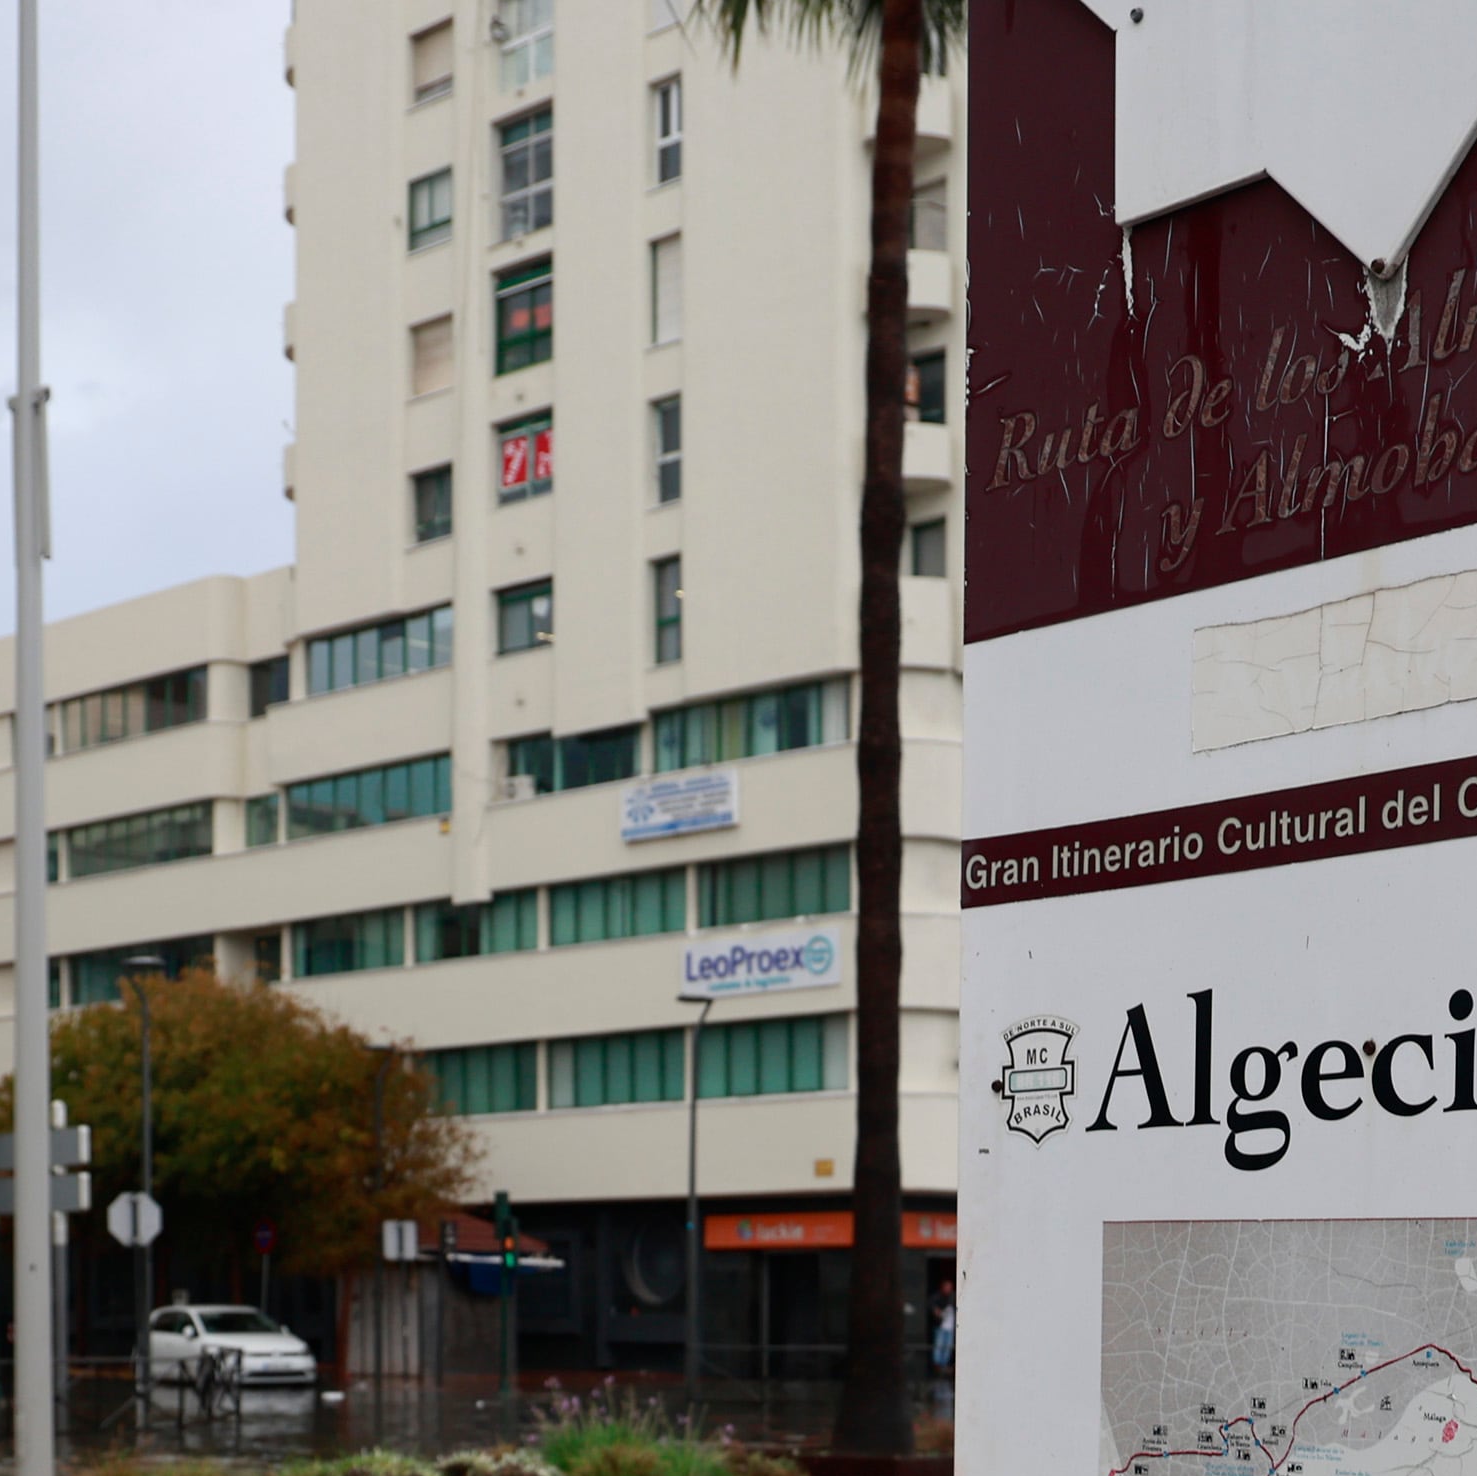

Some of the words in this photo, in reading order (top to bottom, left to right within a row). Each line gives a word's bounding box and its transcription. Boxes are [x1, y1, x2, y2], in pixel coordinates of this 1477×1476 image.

[986, 402, 1141, 493] Ruta
[1163, 353, 1234, 440] de
[1256, 325, 1351, 413] los
[1159, 498, 1205, 573] y
[965, 854, 1040, 891] Gran
[1051, 825, 1204, 880] Itinerario
[1217, 795, 1367, 856] Cultural
[1381, 782, 1441, 830] del
[685, 945, 806, 982] LeoProex
[1016, 1018, 1049, 1033] NORTE
[1050, 1019, 1057, 1027] A
[1058, 1021, 1077, 1035] SUL
[1026, 1047, 1049, 1065] MC
[1013, 1103, 1062, 1125] BRASIL
